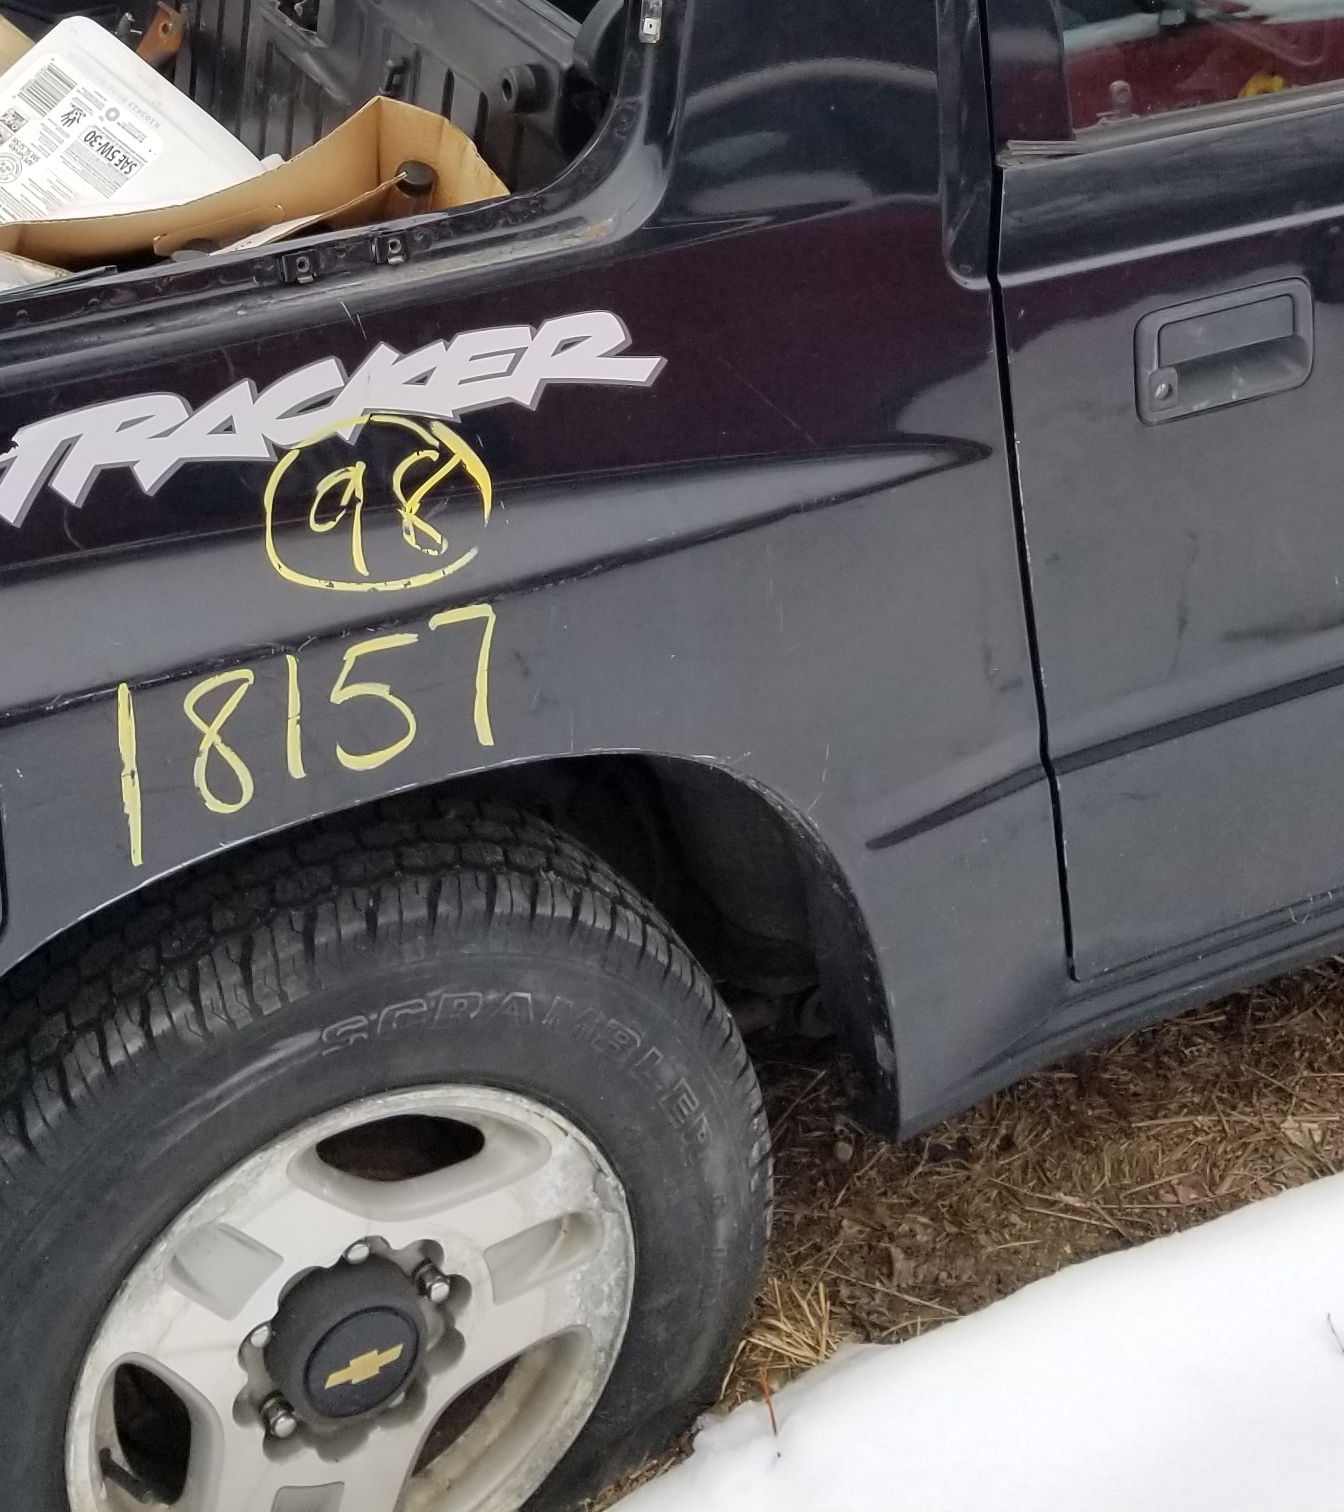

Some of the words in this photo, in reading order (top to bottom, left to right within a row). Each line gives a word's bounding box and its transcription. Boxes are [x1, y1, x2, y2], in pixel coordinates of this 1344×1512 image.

[84, 130, 119, 162] 5W-30
[114, 153, 137, 175] SAE
[309, 448, 466, 578] 98
[117, 603, 498, 868] 18157
[320, 990, 714, 1166] SCRAMBLER
